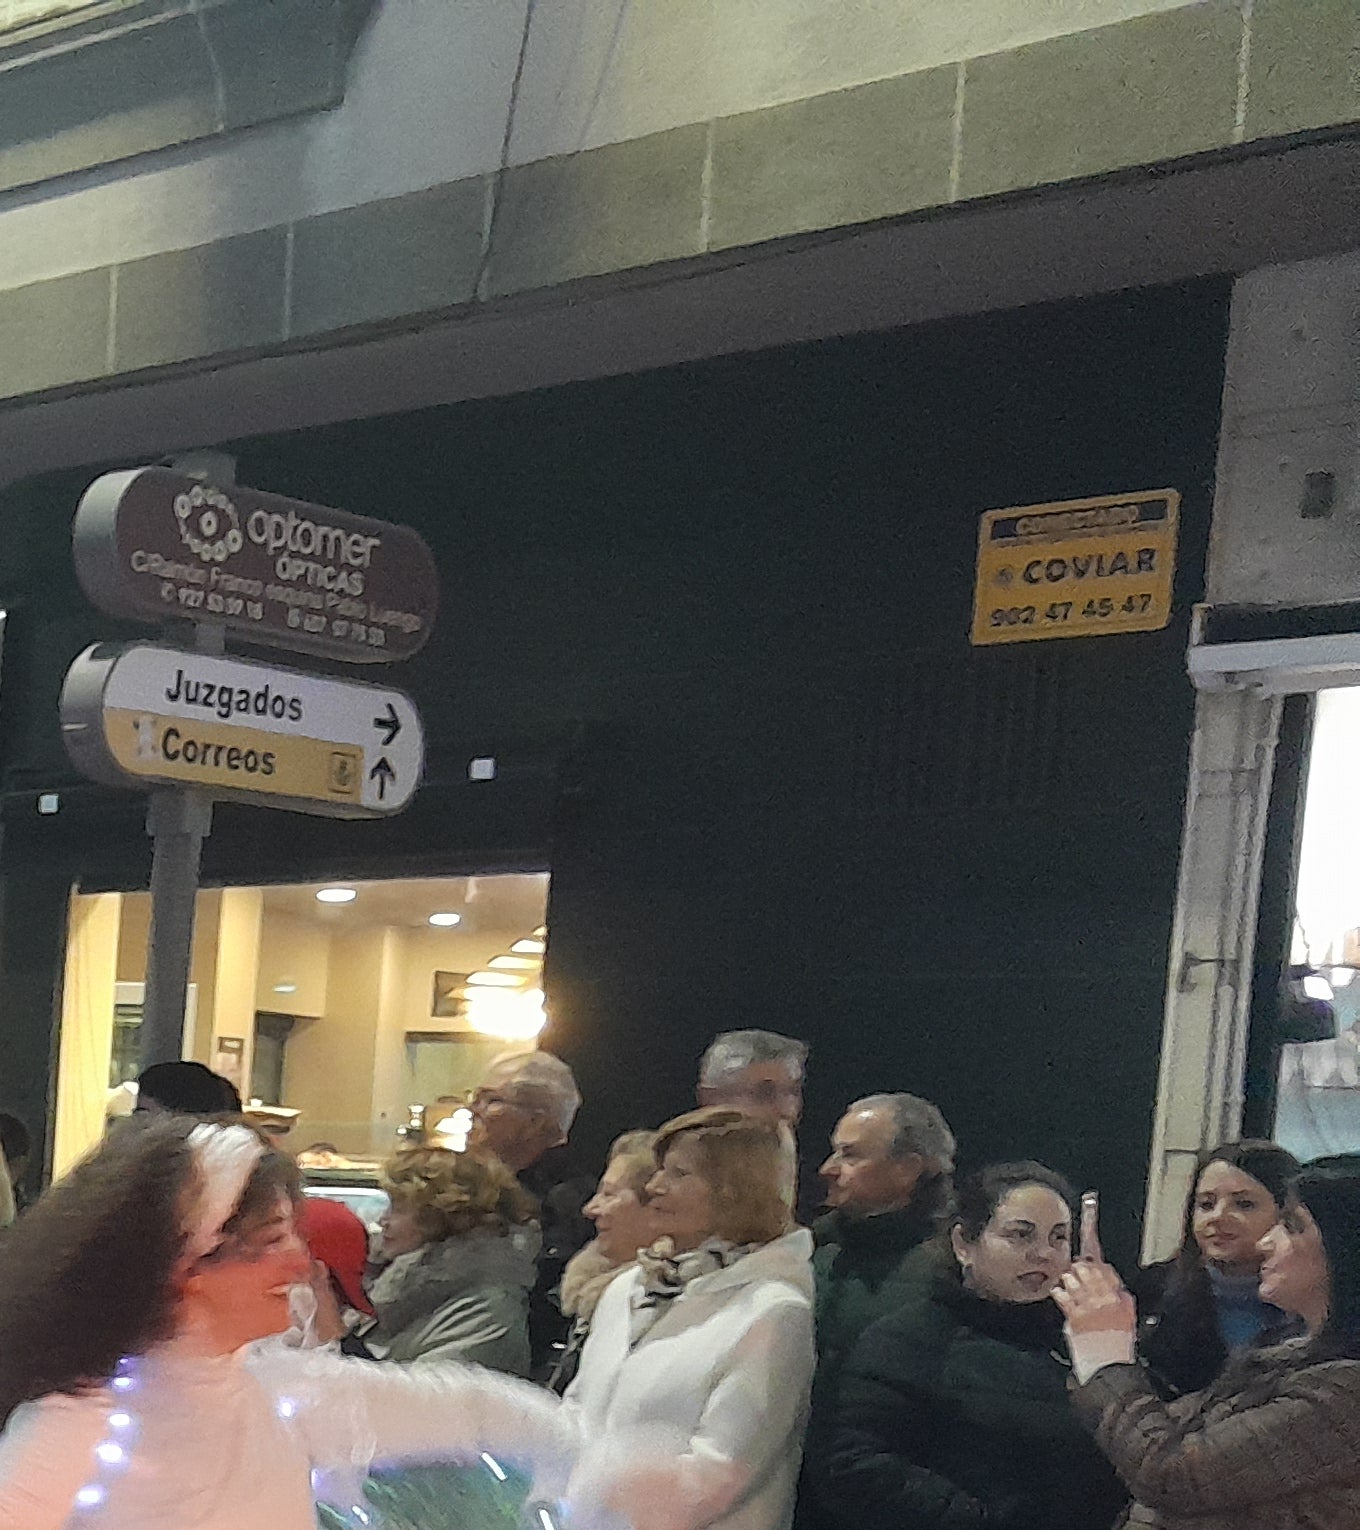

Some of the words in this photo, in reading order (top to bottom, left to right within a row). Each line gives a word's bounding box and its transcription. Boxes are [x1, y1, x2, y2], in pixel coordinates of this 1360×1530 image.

[247, 509, 381, 569] optomer
[276, 551, 364, 597] ÓPTICAS
[1023, 548, 1157, 584] COVIAR
[1045, 601, 1073, 620] 47
[1121, 593, 1152, 612] 47
[165, 669, 304, 722] Juzgados
[161, 727, 276, 775] Correos
